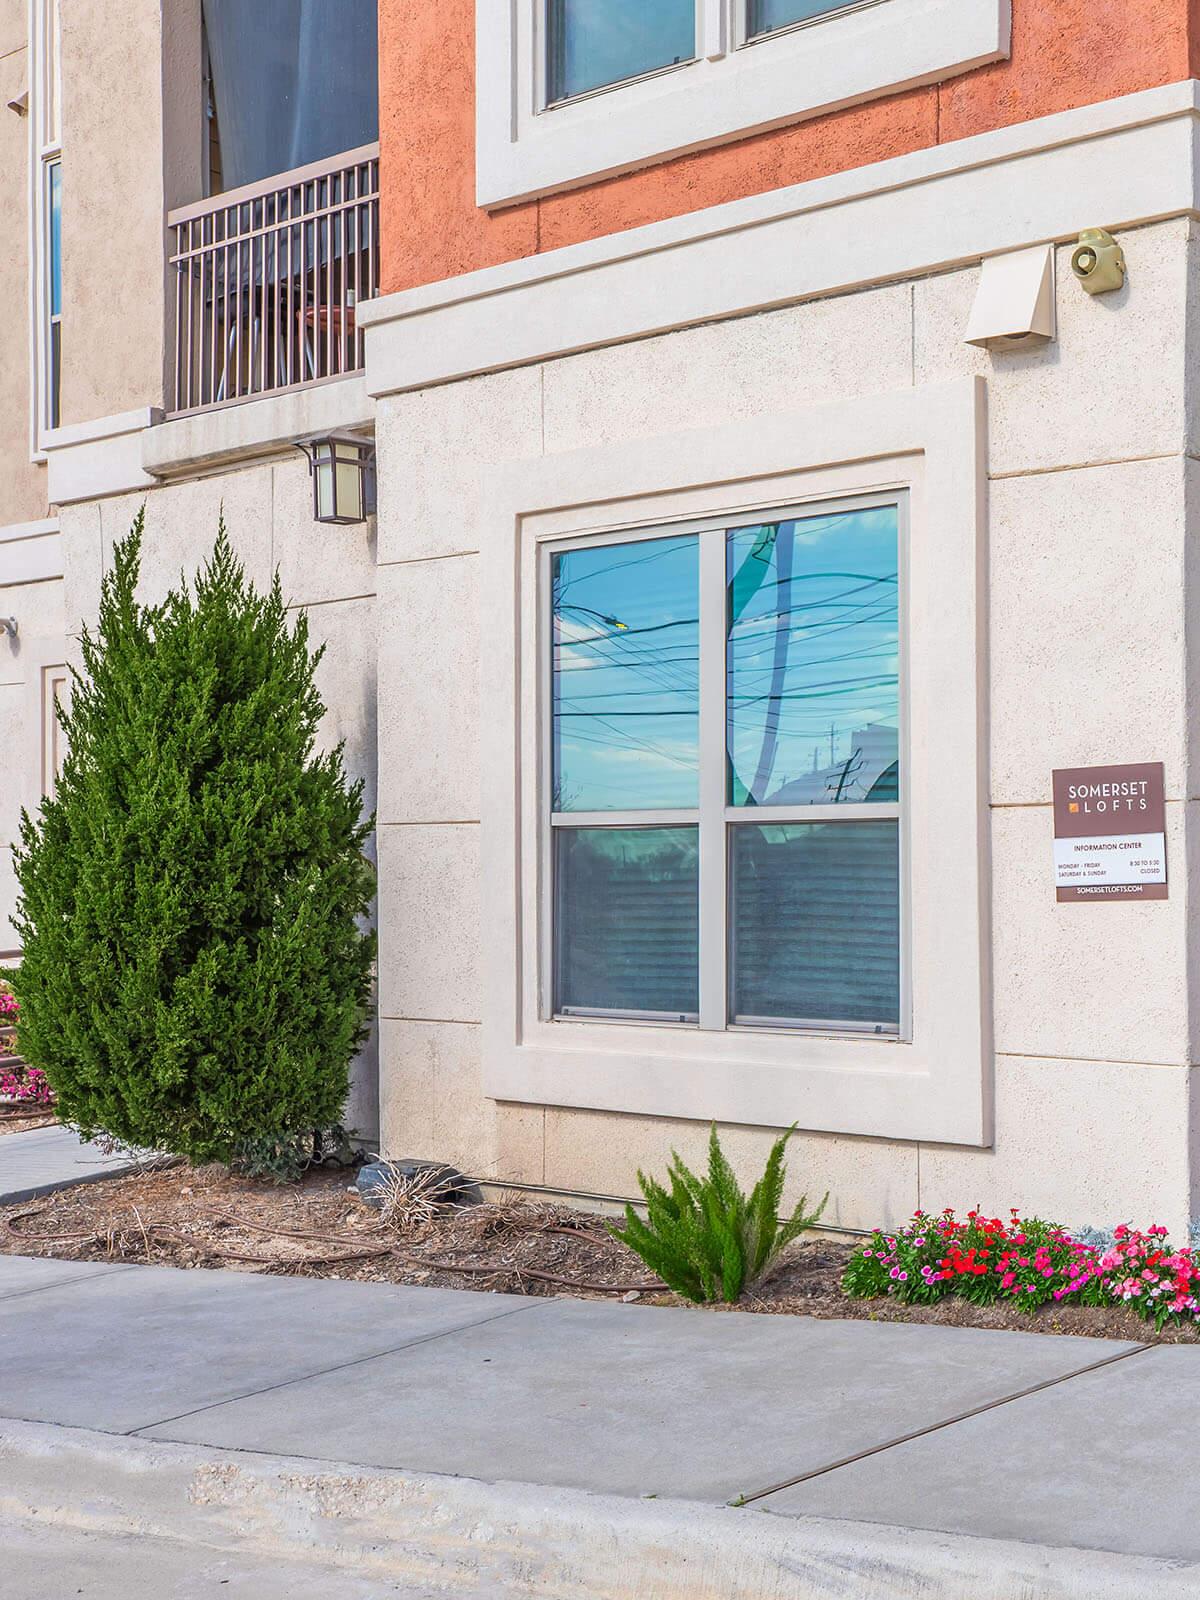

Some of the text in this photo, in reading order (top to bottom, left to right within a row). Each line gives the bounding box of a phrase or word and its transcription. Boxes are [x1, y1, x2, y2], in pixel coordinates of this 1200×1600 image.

[1068, 781, 1147, 798] SOMERSET
[1084, 798, 1147, 813] LOFTS
[1074, 842, 1142, 852] INFORMATION CENTER
[1077, 885, 1143, 894] SOMERSETLOFTS.COM
